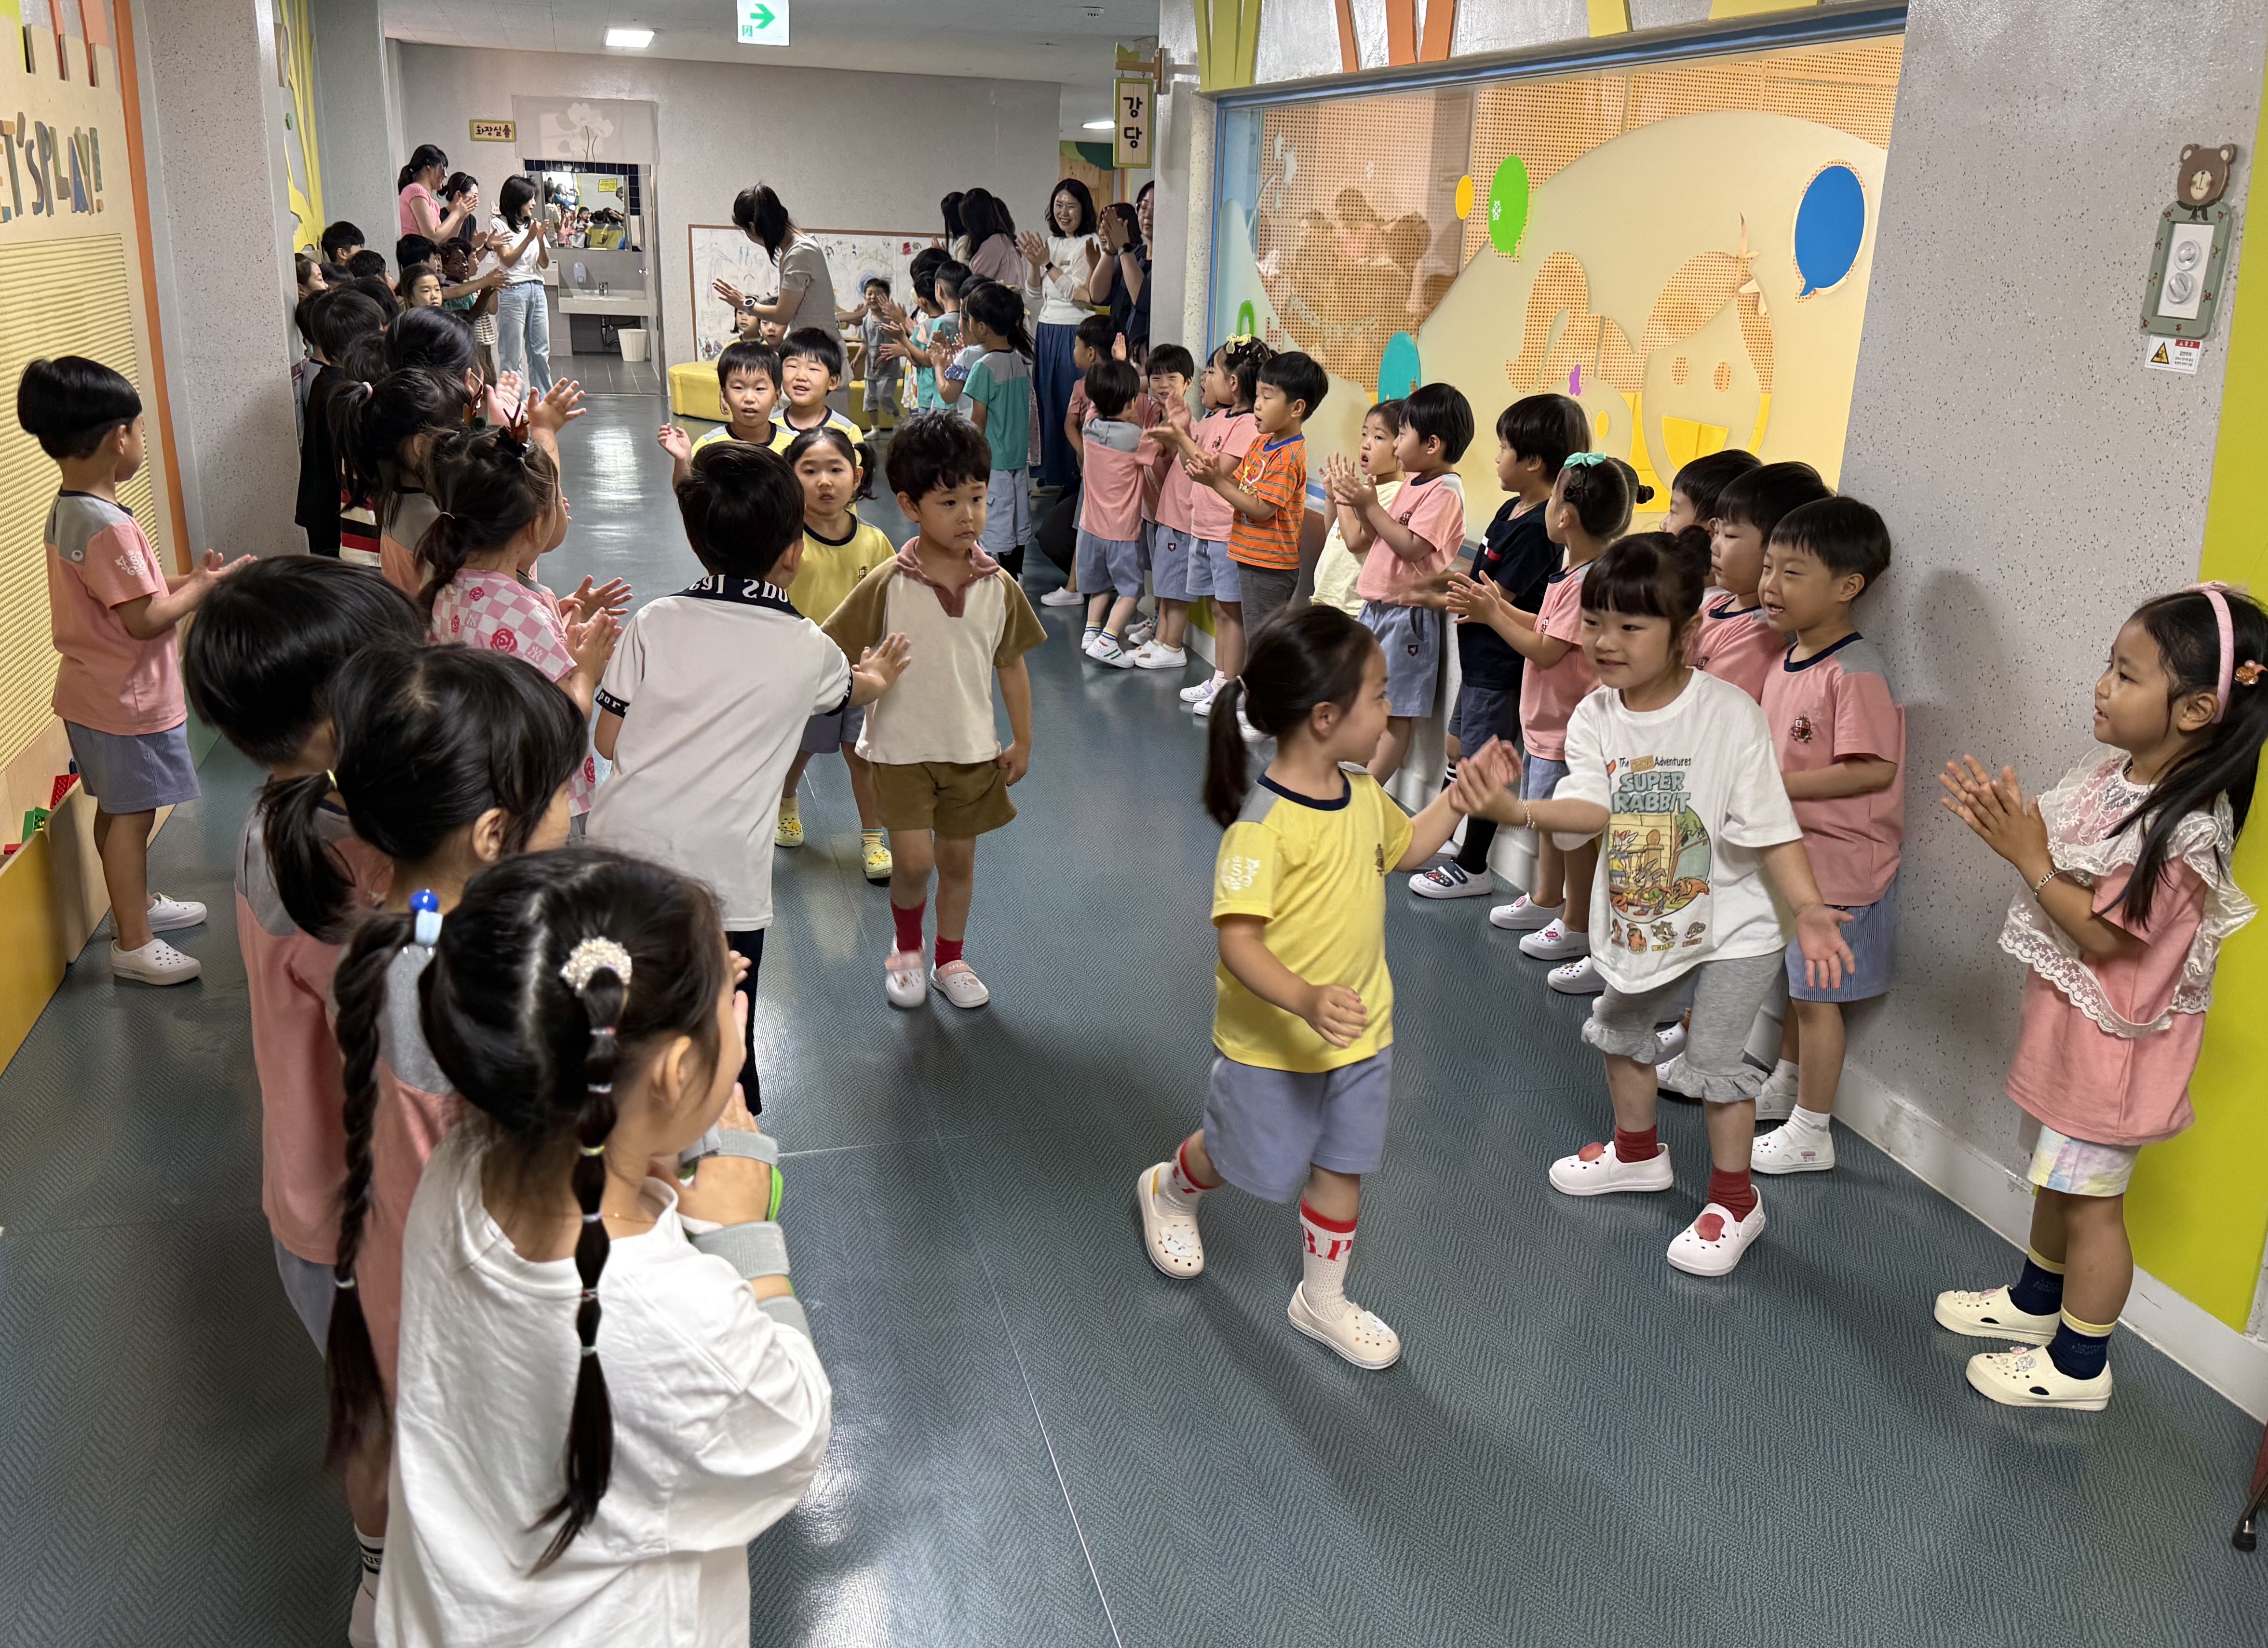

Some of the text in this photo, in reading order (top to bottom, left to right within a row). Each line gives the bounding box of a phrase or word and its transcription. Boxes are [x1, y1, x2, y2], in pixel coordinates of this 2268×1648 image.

[476, 124, 502, 136] 화장실
[1123, 97, 1143, 148] 강당
[34, 121, 104, 217] PLAY!
[1619, 757, 1629, 768] The
[1654, 756, 1691, 767] Adventures
[1619, 771, 1686, 792] SUPER
[1612, 791, 1691, 814] RABBIT
